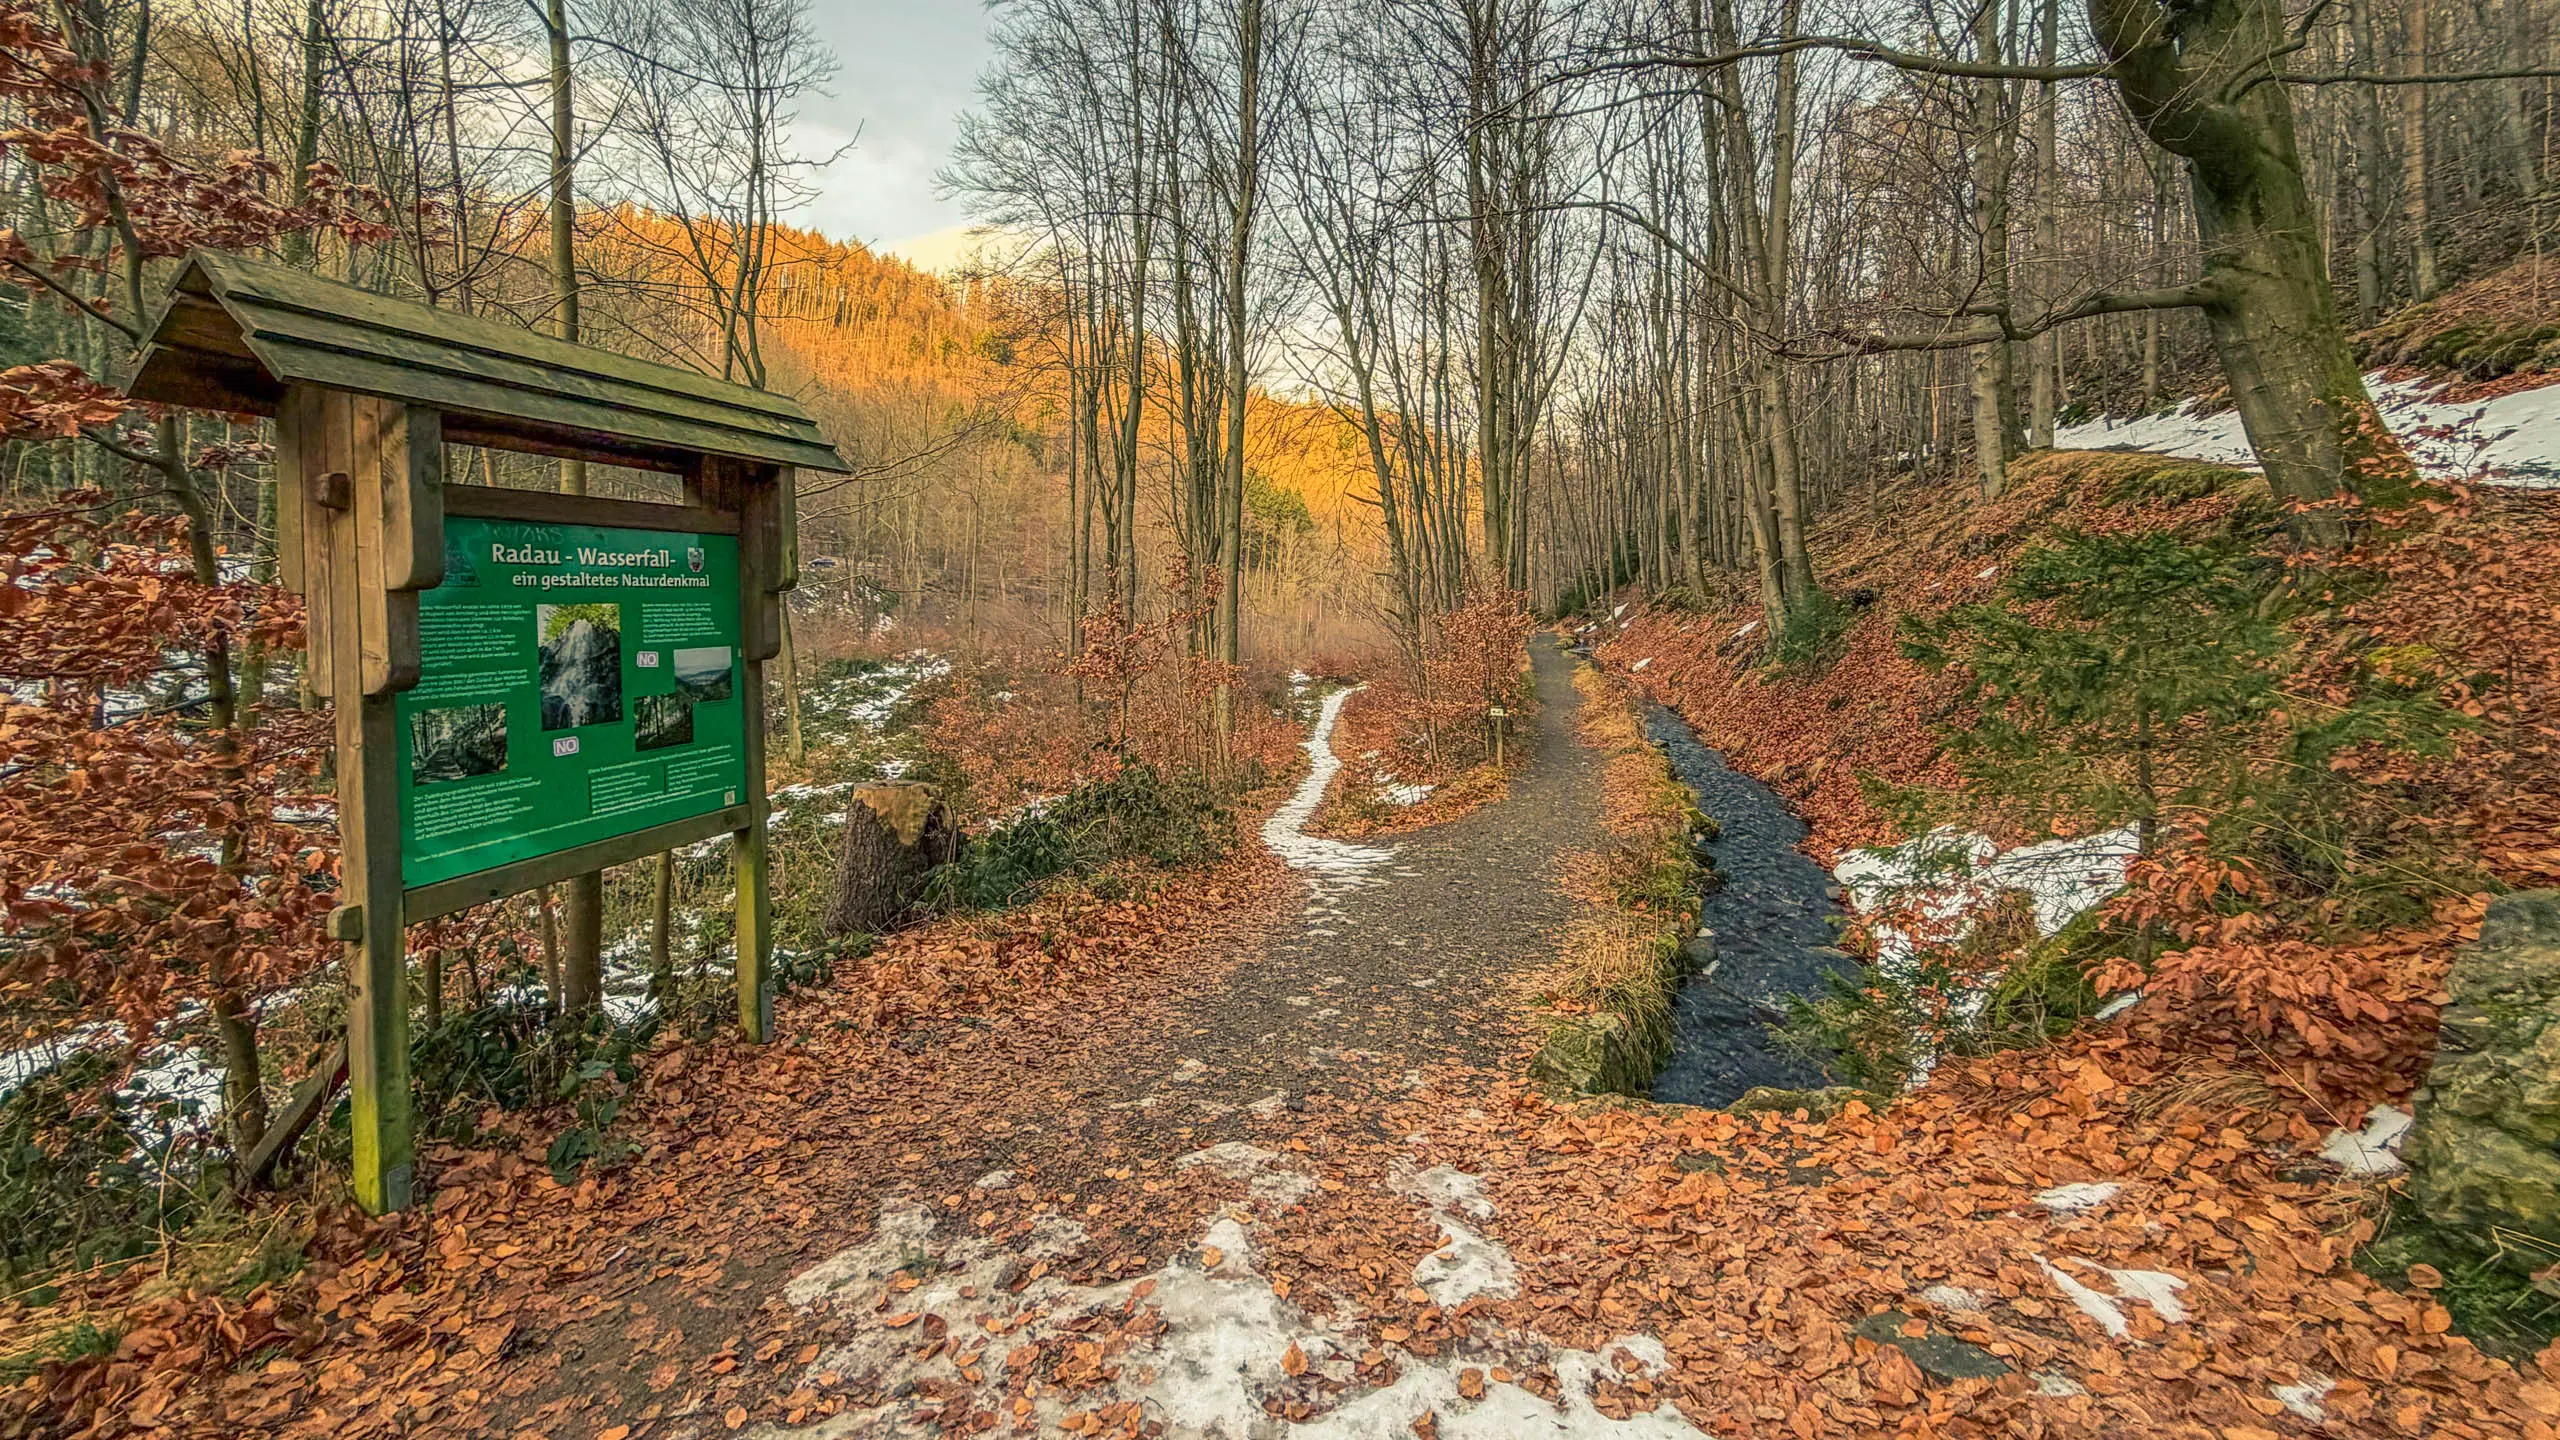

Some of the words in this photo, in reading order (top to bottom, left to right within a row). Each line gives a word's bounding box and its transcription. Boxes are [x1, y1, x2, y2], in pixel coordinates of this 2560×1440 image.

[492, 543, 562, 564] Radau
[512, 571, 537, 586] ein
[541, 571, 619, 590] gestaltetes
[622, 573, 710, 588] Naturdenkmal
[639, 653, 657, 666] NO
[555, 738, 577, 754] NO
